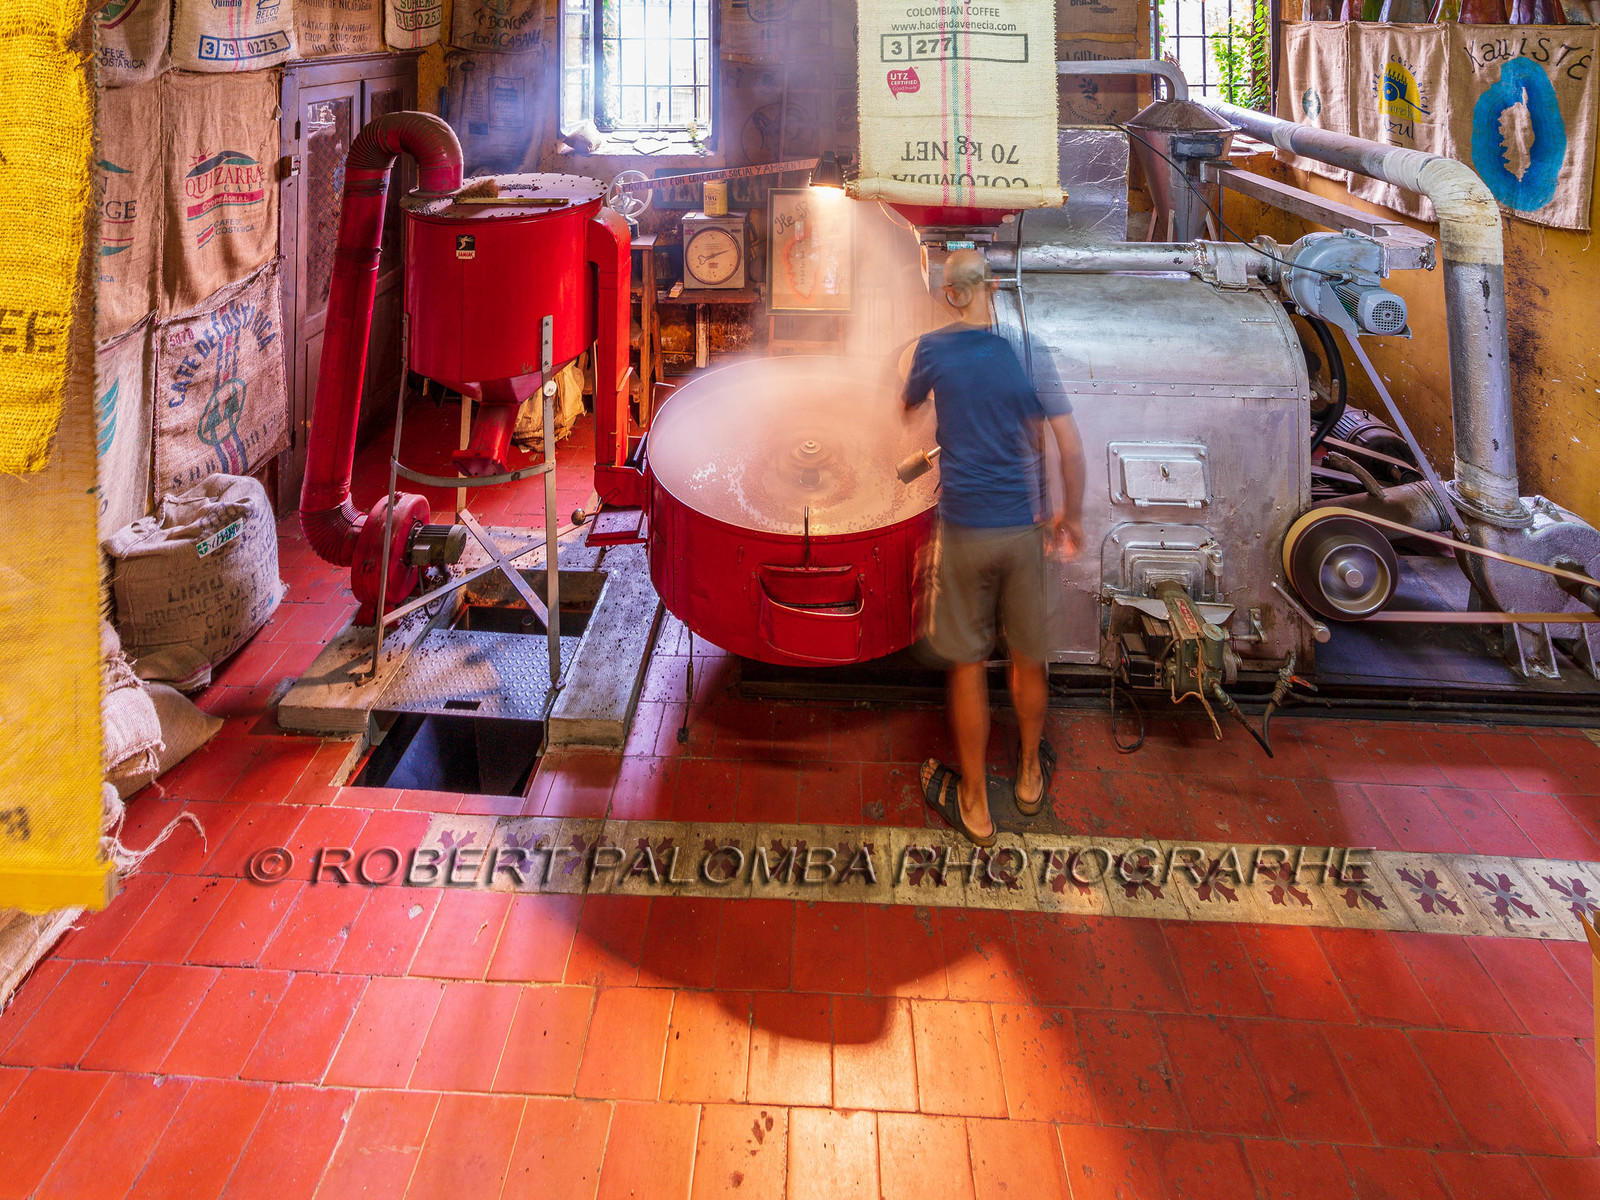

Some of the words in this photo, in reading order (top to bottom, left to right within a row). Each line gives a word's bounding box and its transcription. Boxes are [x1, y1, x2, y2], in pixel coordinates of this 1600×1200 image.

[906, 6, 963, 17] COLOMBIAN
[966, 6, 1000, 17] COFFEE
[891, 21, 1017, 31] www.haciendavenecia.com
[204, 42, 214, 55] 3
[222, 43, 235, 56] 79
[247, 38, 278, 55] 0275
[891, 40, 902, 55] 3
[916, 37, 952, 54] 277
[901, 141, 949, 161] NET
[957, 135, 983, 161] kg
[991, 143, 1020, 165] 70
[185, 165, 264, 199] QUIZARRA
[670, 175, 685, 187] CON
[729, 166, 753, 178] SOCIAL
[223, 182, 263, 192] CAFE
[213, 219, 235, 228] CAFE
[168, 355, 202, 408] CAFE
[194, 329, 218, 359] DE
